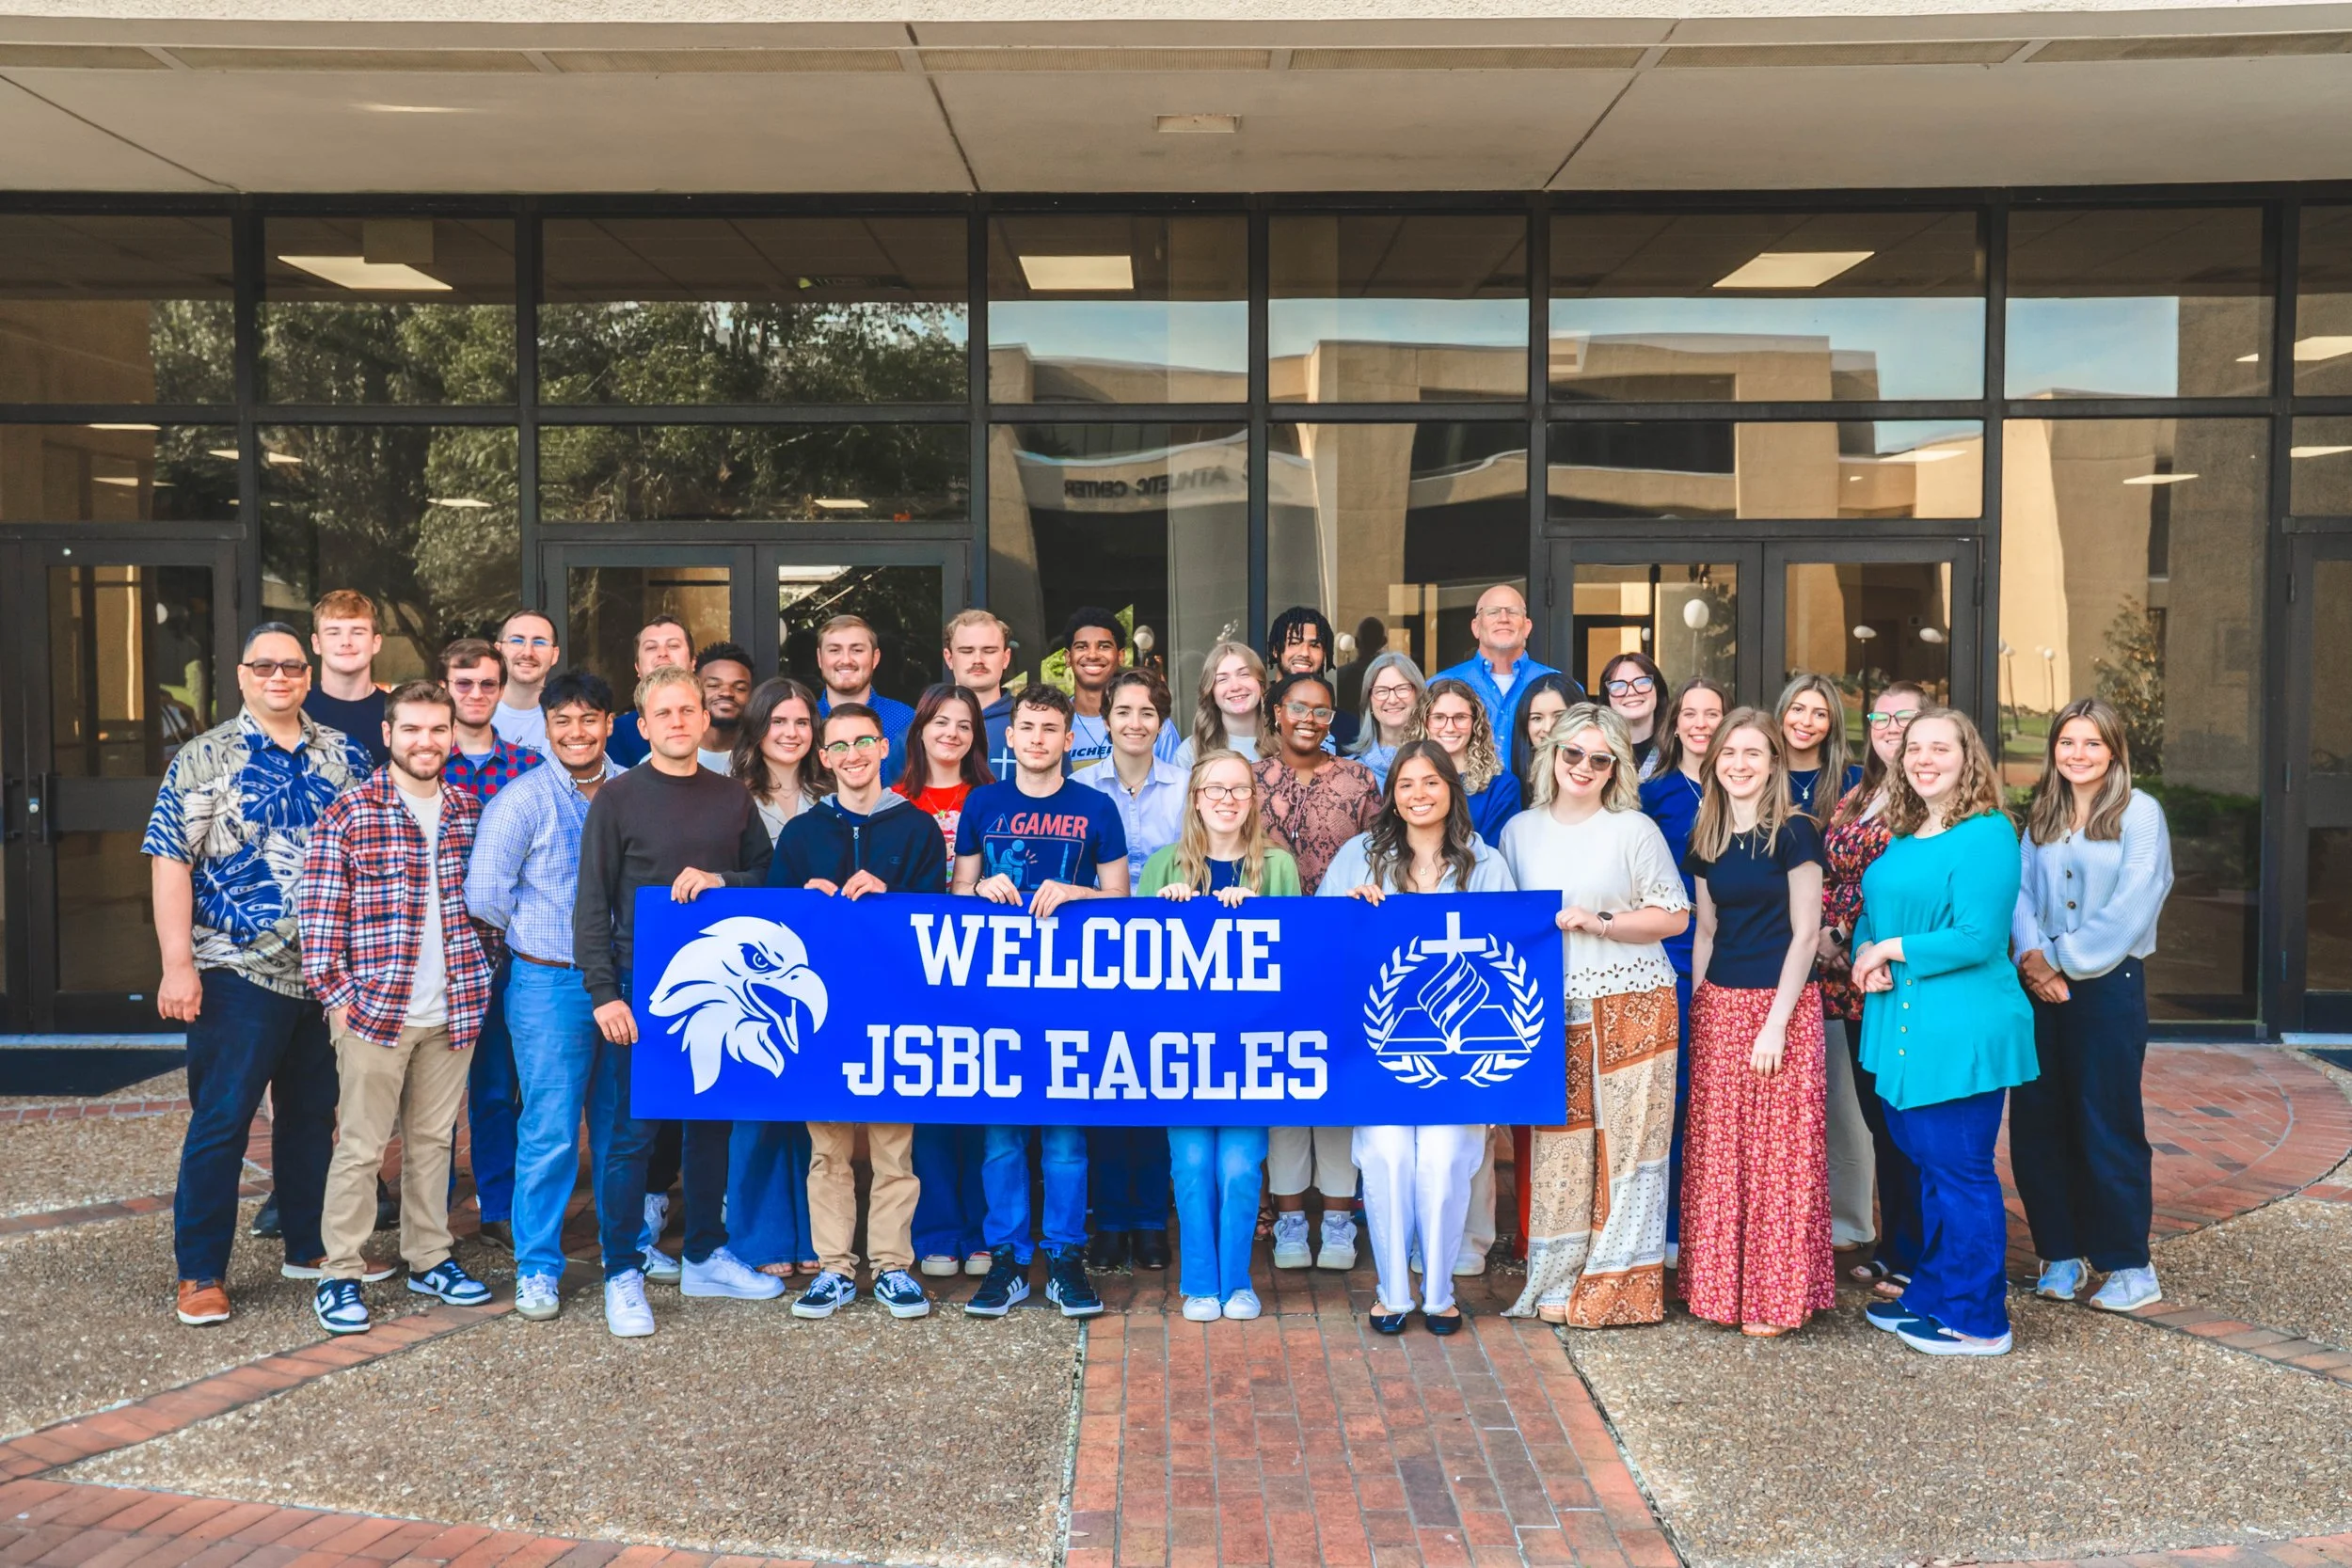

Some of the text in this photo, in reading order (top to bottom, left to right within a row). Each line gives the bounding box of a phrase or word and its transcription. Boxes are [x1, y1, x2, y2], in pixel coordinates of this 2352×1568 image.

[1010, 813, 1089, 839] GAMER
[911, 914, 1280, 990] WELCOME
[843, 1025, 1327, 1099] JSBC EAGLES
